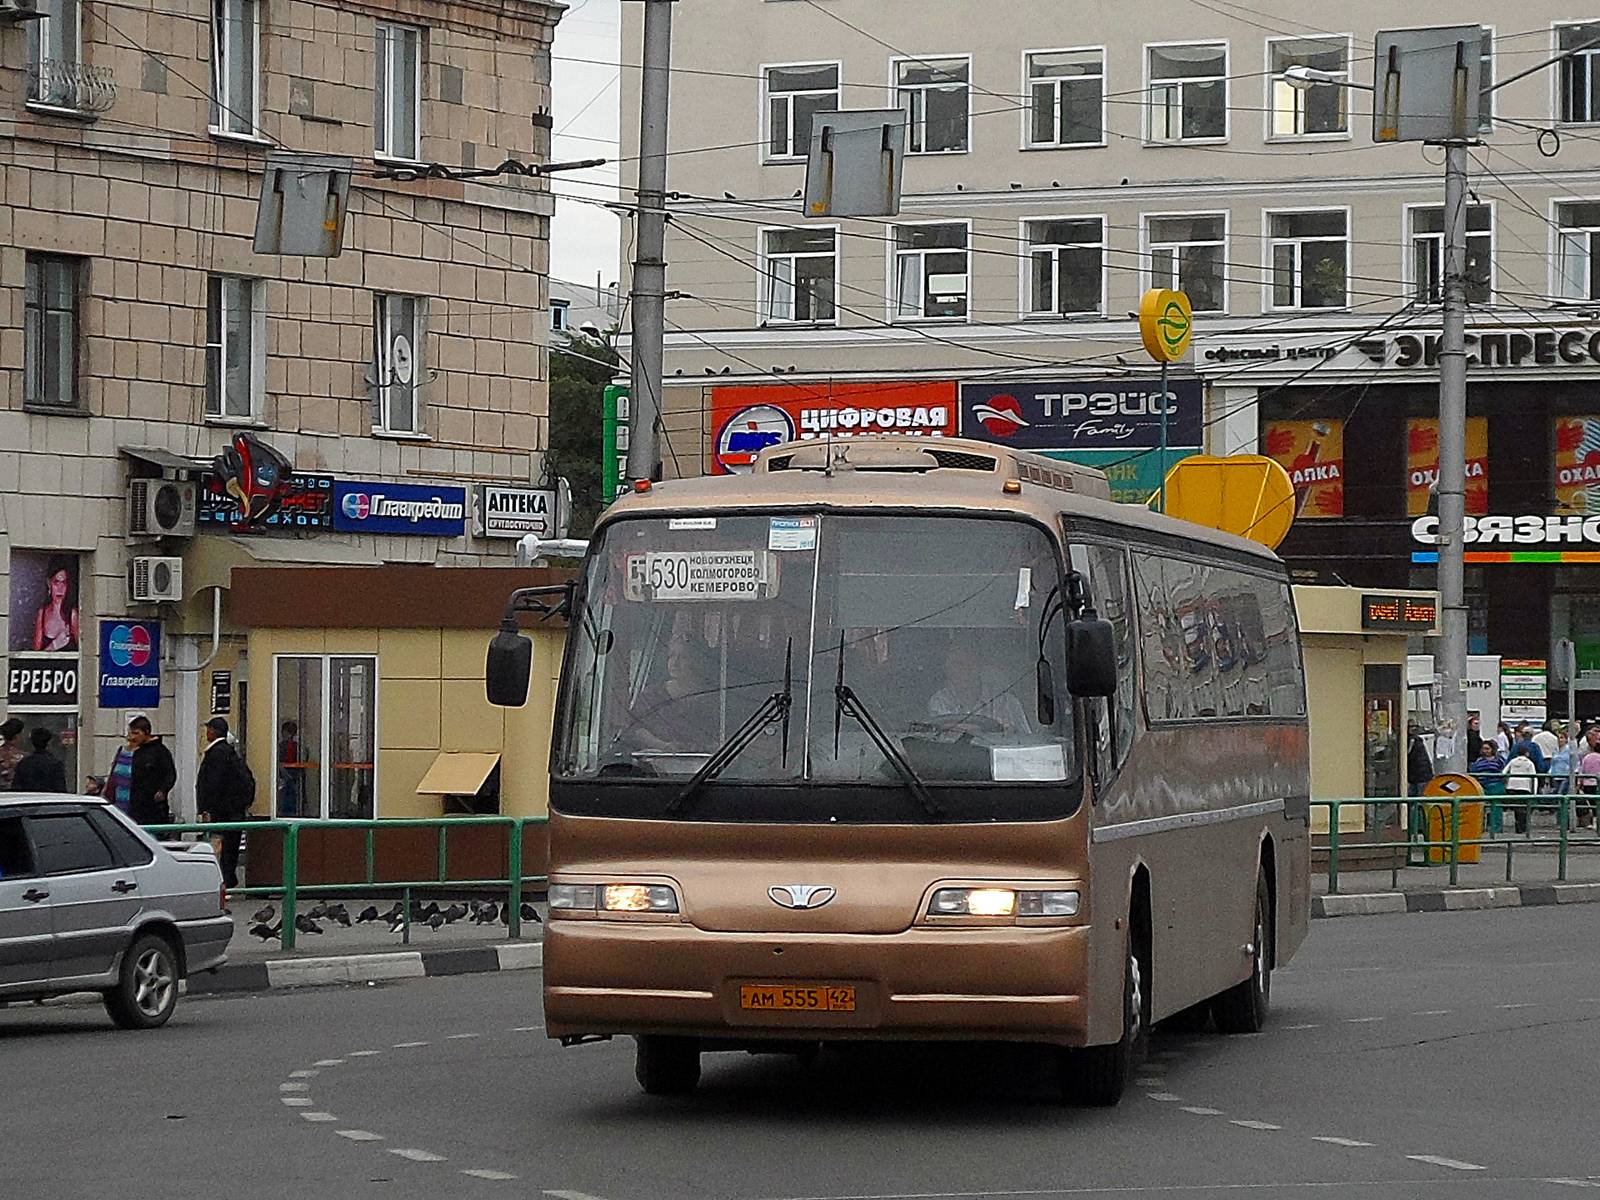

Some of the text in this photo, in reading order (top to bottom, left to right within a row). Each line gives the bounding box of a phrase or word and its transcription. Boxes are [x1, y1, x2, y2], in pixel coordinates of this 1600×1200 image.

[800, 406, 947, 431] ЦИФРОВАЯ
[1072, 419, 1135, 439] Family
[1559, 465, 1600, 484] ОХА
[369, 494, 463, 522] Главкредит
[488, 492, 548, 514] АПТЕКА
[689, 556, 753, 565] НОВОКУЗНЕЦК
[651, 558, 688, 589] 530
[690, 567, 760, 579] КОЛМОГОРОВО
[690, 581, 755, 593] КЕМЕРОВО
[9, 669, 77, 694] ЕРЕБРО
[101, 673, 158, 688] Главкредит
[750, 990, 849, 1007] АМ 555 42
